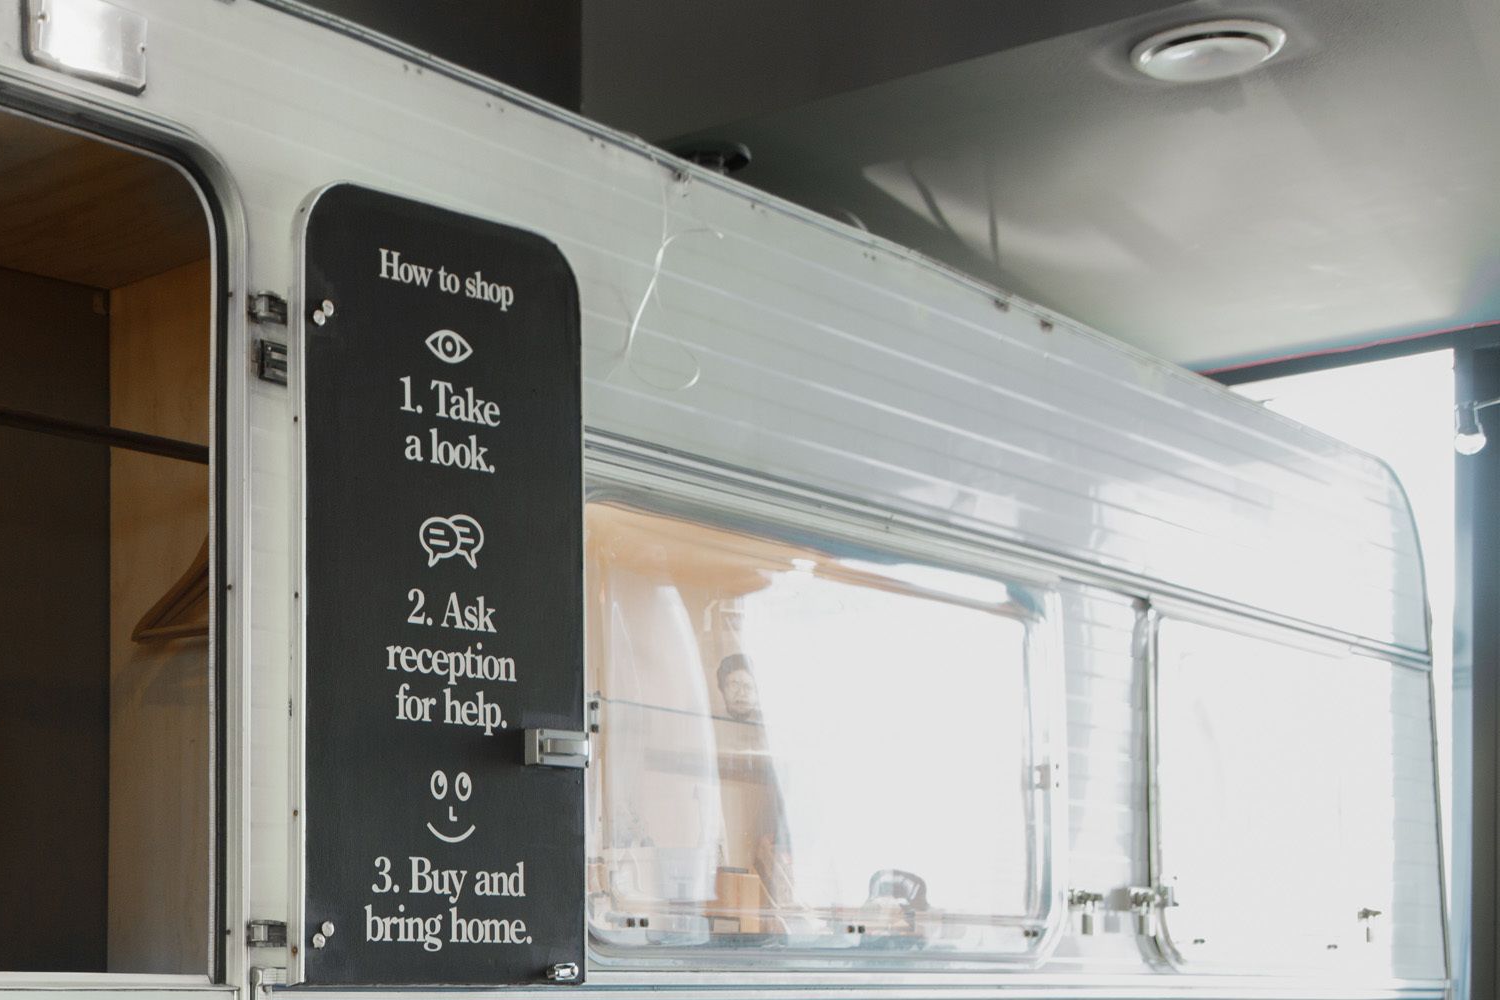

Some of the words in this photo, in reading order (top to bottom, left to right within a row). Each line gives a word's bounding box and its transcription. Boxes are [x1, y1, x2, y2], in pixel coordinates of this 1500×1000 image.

[379, 248, 433, 288] How
[438, 266, 460, 294] to
[465, 271, 514, 312] shop
[399, 375, 423, 414] 1.
[430, 379, 501, 427] Take
[404, 435, 424, 462] a
[429, 427, 496, 474] look.
[407, 588, 433, 626] 2.
[440, 591, 498, 633] Ask
[385, 641, 518, 686] reception
[395, 682, 437, 722] for
[442, 687, 508, 736] help.
[371, 855, 400, 894] 3.
[408, 856, 468, 904] Buy
[474, 860, 526, 898] and
[363, 903, 443, 952] bring
[448, 906, 533, 945] home.
